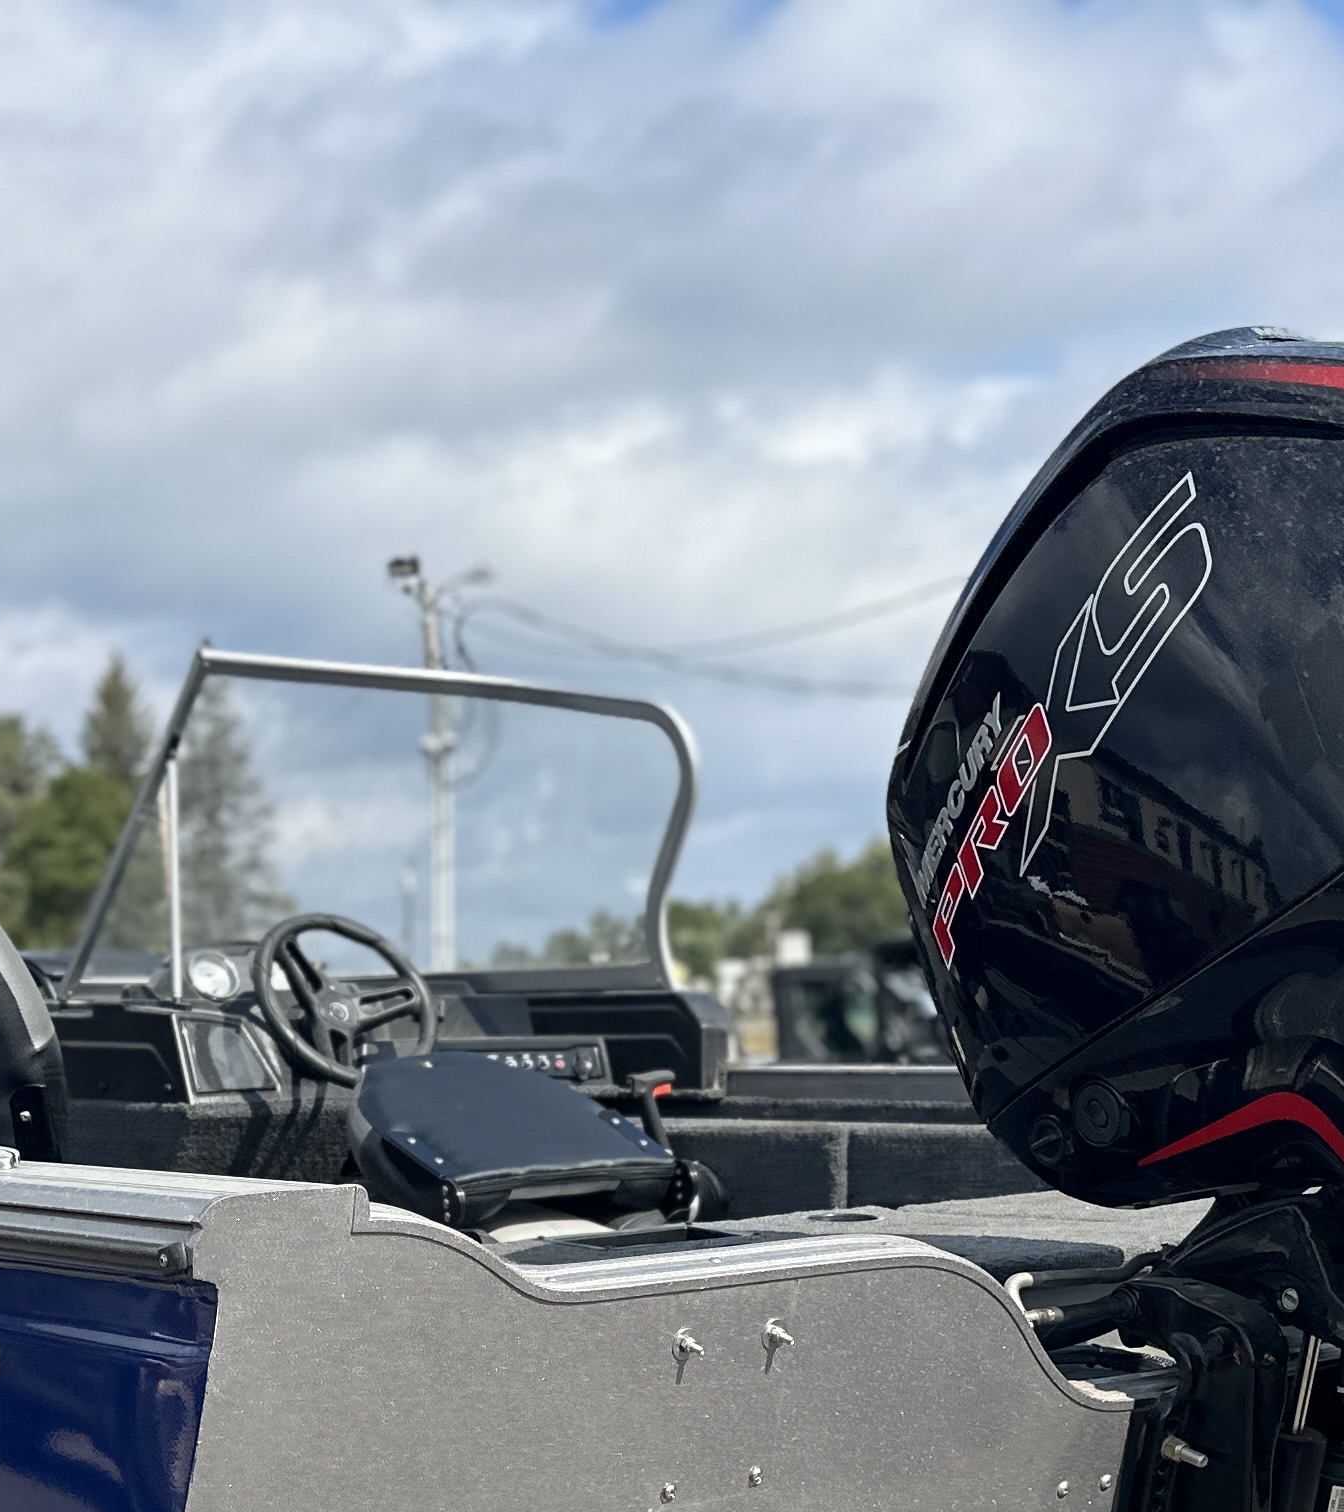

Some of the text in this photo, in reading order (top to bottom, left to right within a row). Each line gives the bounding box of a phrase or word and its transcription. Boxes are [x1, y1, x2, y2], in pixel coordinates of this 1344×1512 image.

[915, 691, 1002, 910] MERCURY
[932, 470, 1213, 972] PRO XS
